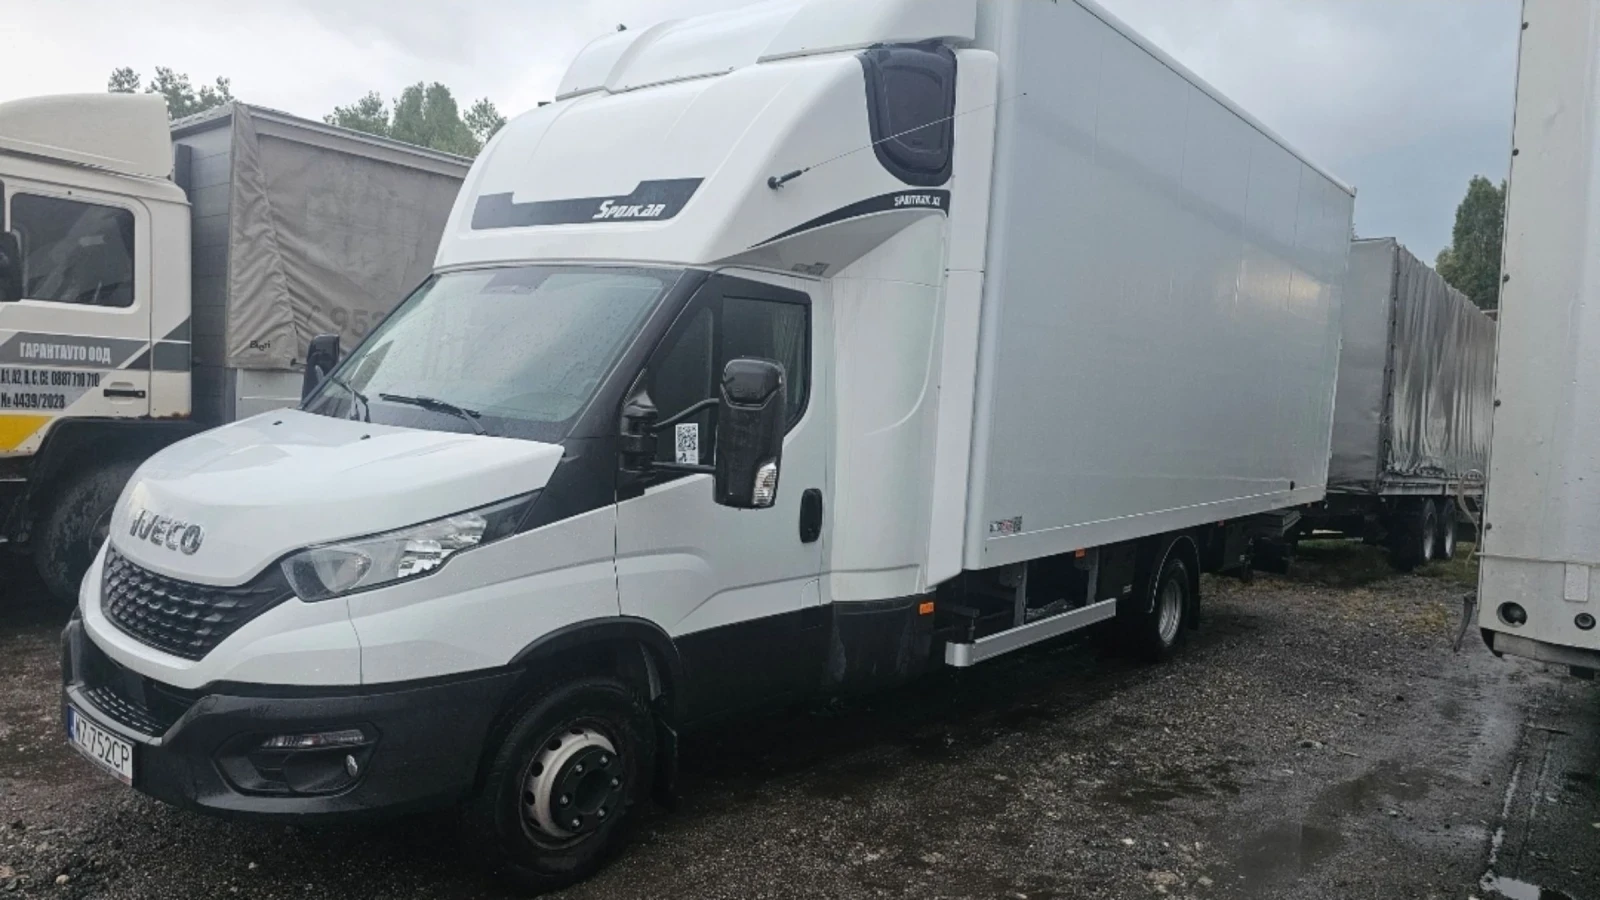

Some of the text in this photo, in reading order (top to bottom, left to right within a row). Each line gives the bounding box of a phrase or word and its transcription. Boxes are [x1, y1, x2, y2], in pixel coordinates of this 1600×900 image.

[19, 341, 112, 364] ГАРАНТАУТО ООД
[129, 508, 205, 556] IVECO
[89, 725, 131, 773] 752CP
